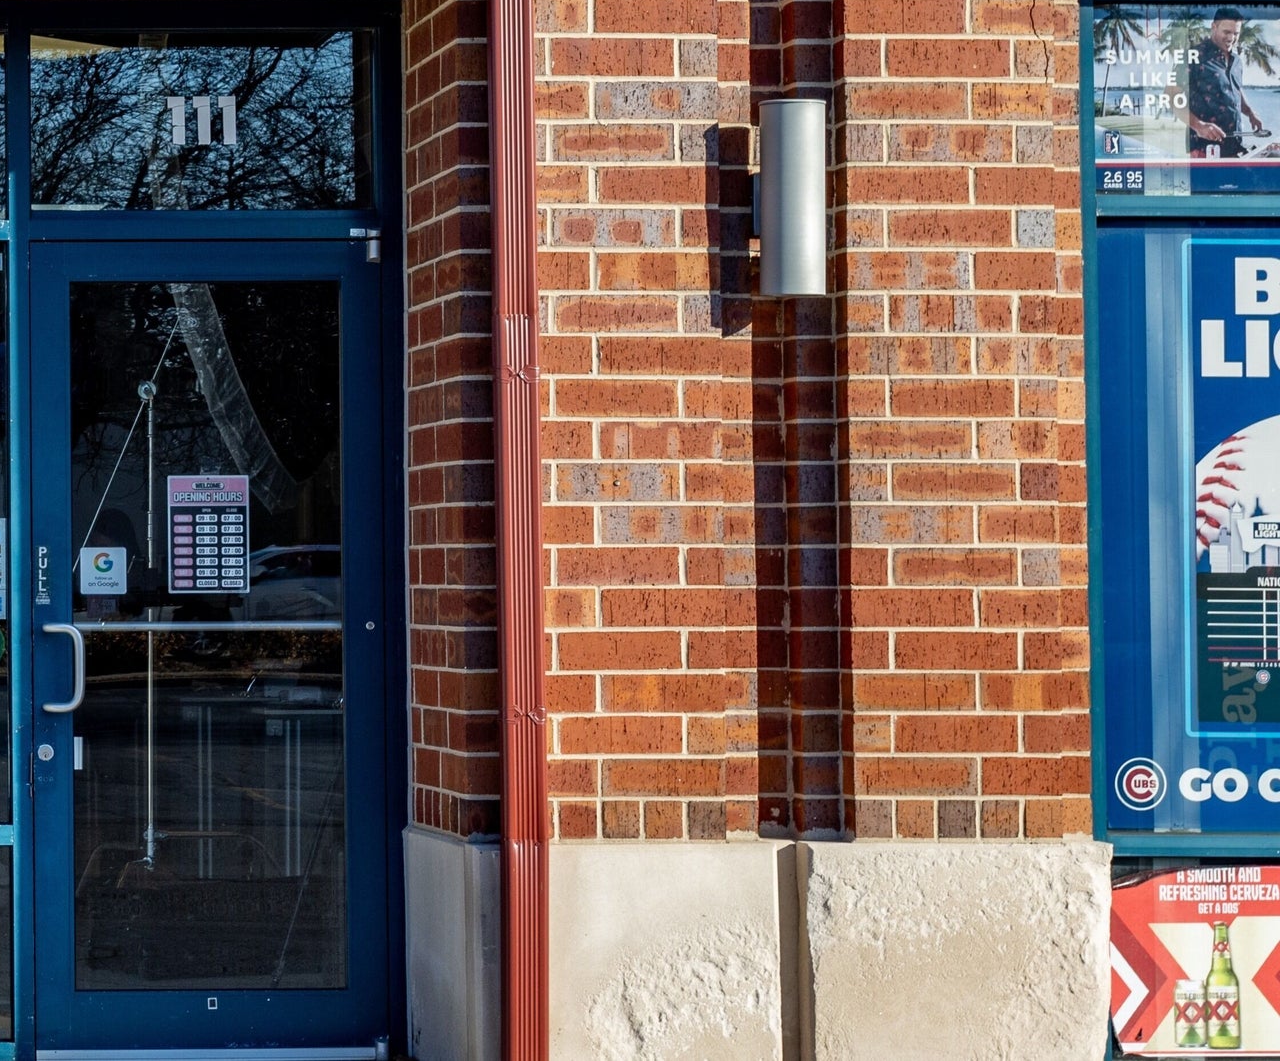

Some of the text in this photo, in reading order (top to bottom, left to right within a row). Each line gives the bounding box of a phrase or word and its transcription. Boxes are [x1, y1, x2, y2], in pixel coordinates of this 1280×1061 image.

[1105, 49, 1200, 65] SUMMER
[1129, 72, 1177, 87] LIKE
[1119, 93, 1188, 109] A PRO
[166, 95, 237, 145] 111
[1104, 171, 1143, 183] 2.6 95
[173, 492, 243, 502] OPENING HOURS
[1258, 523, 1278, 531] BUD
[38, 546, 48, 592] PULL
[1179, 767, 1248, 802] GO
[1176, 866, 1261, 883] A SMOOTH AND
[1159, 884, 1280, 901] REFRESHING CERVEZA
[1198, 902, 1239, 914] GET A DOS
